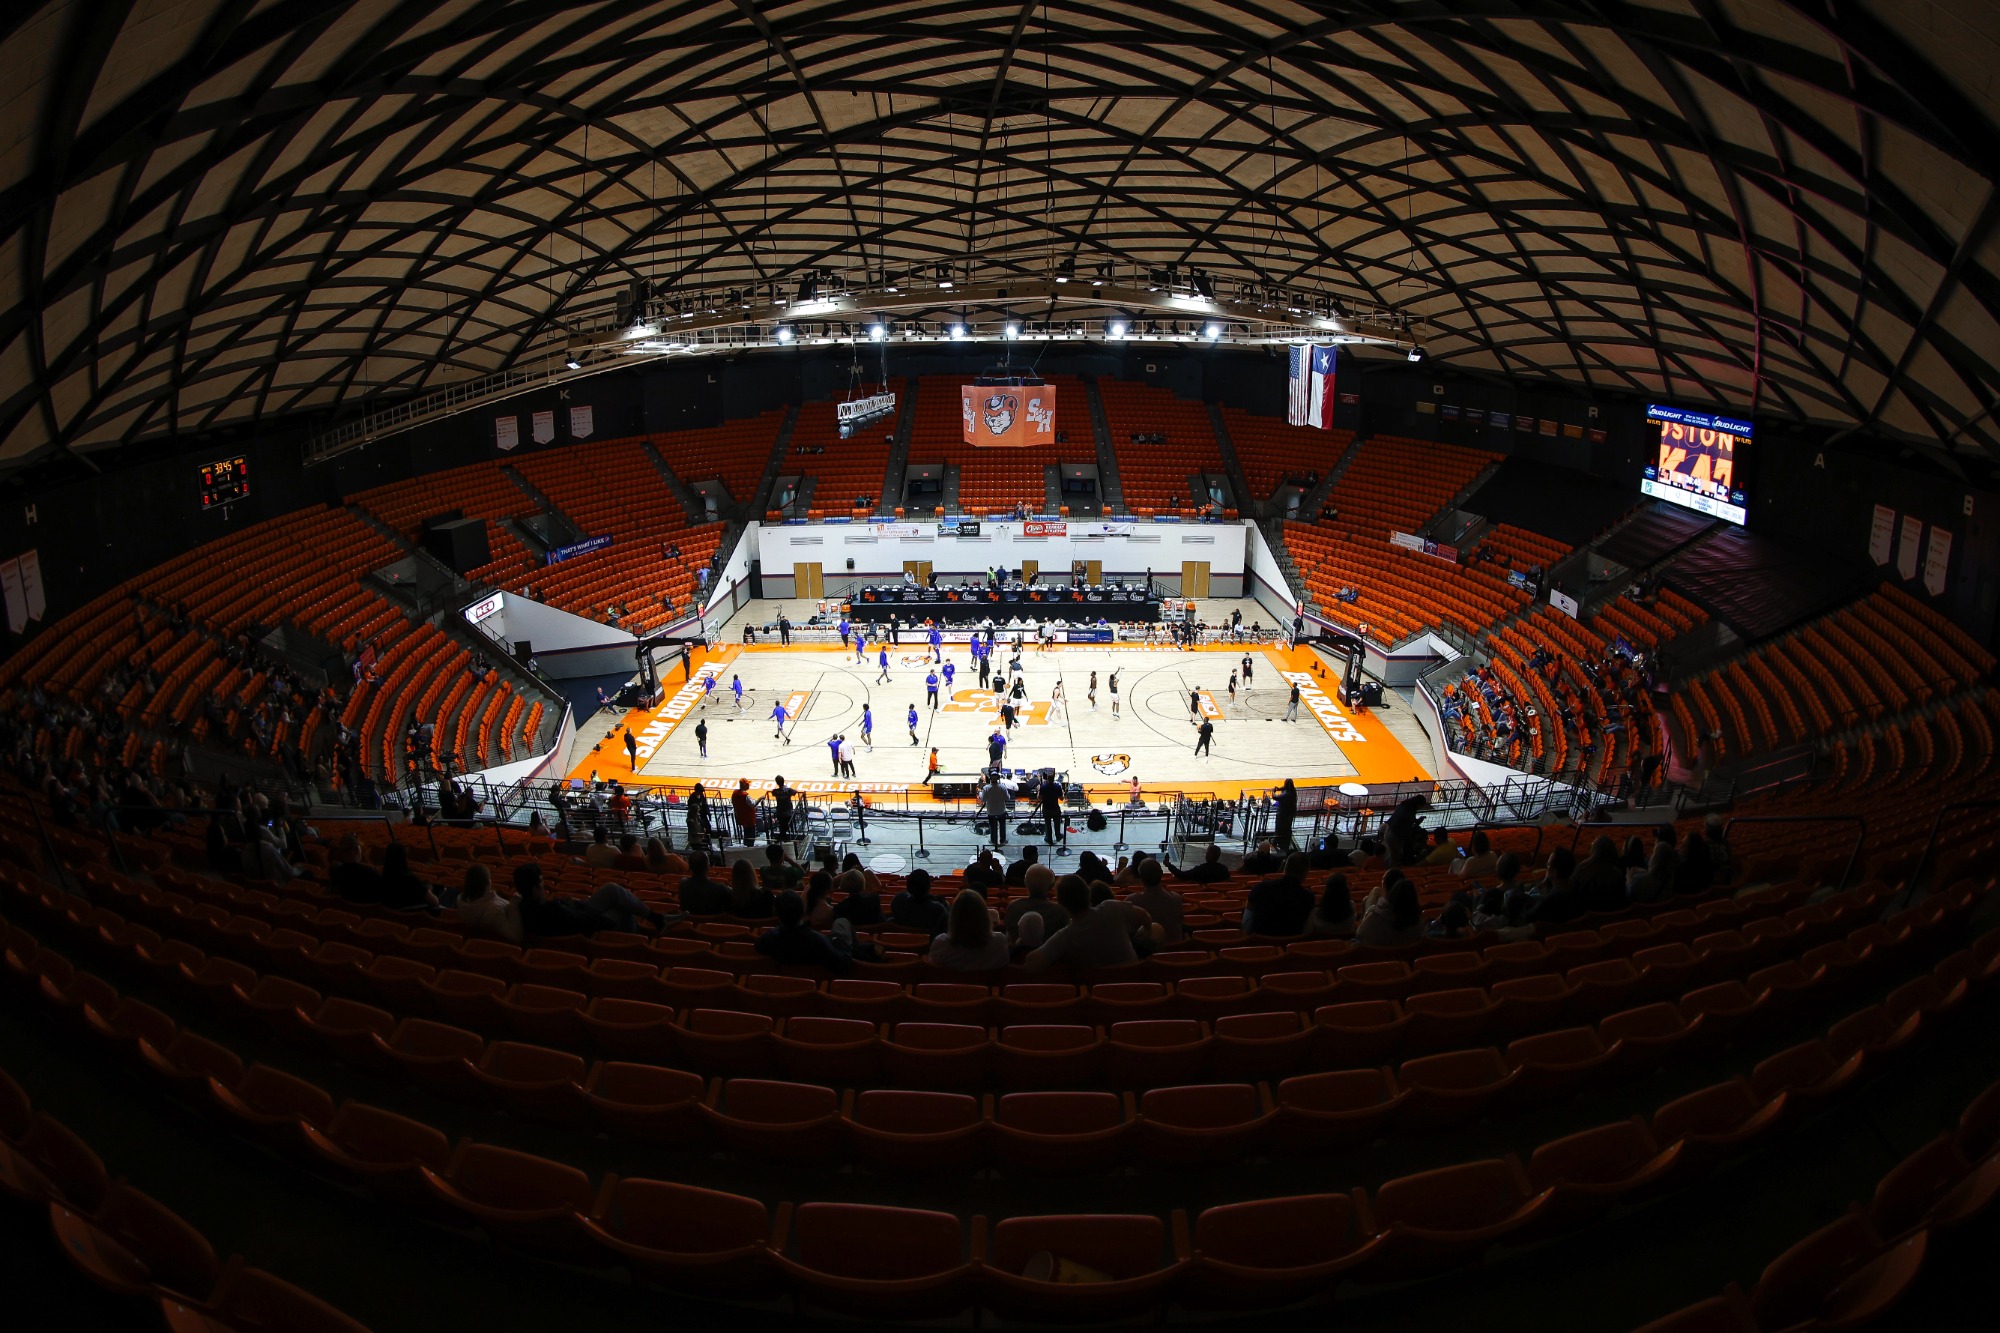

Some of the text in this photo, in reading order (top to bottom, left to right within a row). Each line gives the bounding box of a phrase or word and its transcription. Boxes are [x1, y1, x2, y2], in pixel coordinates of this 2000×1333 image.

[707, 374, 716, 383] L
[559, 389, 570, 399] K
[1663, 411, 1683, 420] LIGHT
[1729, 423, 1751, 433] LIGHT
[1814, 453, 1824, 468] A
[1963, 494, 1974, 516] B
[25, 504, 37, 525] H
[560, 545, 577, 555] THAT'S
[577, 542, 590, 551] WHAT
[622, 661, 728, 758] SAM HOUSTON
[1281, 670, 1368, 742] BEARKATS
[797, 781, 910, 794] COLISEUM
